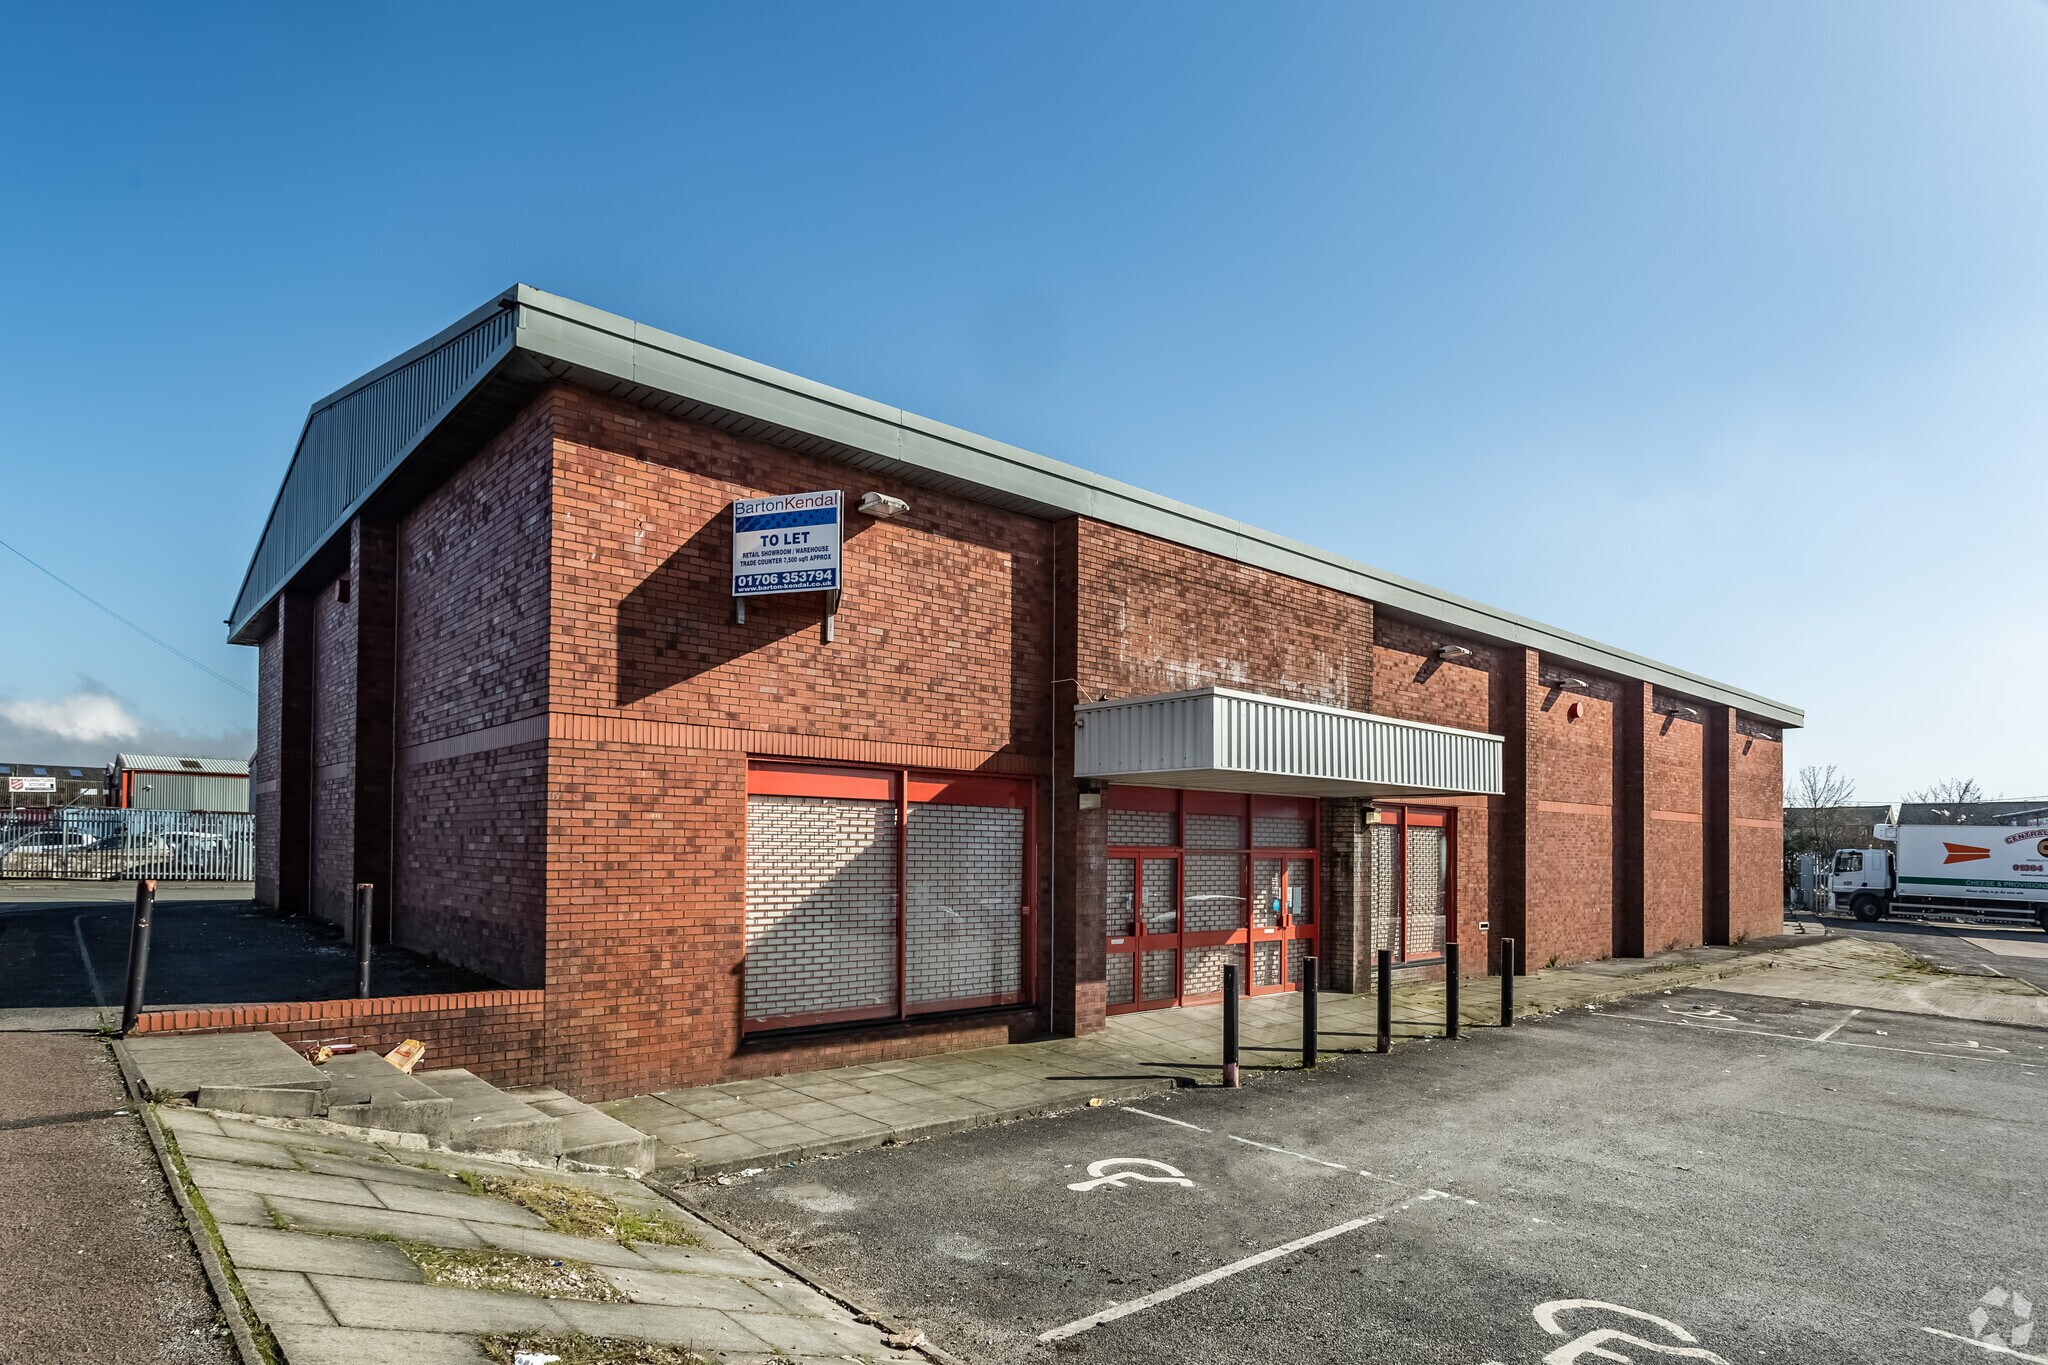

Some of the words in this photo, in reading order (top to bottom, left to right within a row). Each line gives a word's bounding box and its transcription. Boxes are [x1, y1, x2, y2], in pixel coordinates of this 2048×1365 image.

[735, 492, 837, 515] BartonKendal
[760, 534, 779, 547] TO
[784, 532, 810, 545] LET
[738, 574, 778, 586] 01706
[782, 570, 832, 583] 353794
[738, 580, 832, 592] www.barton-kendal.co.uk
